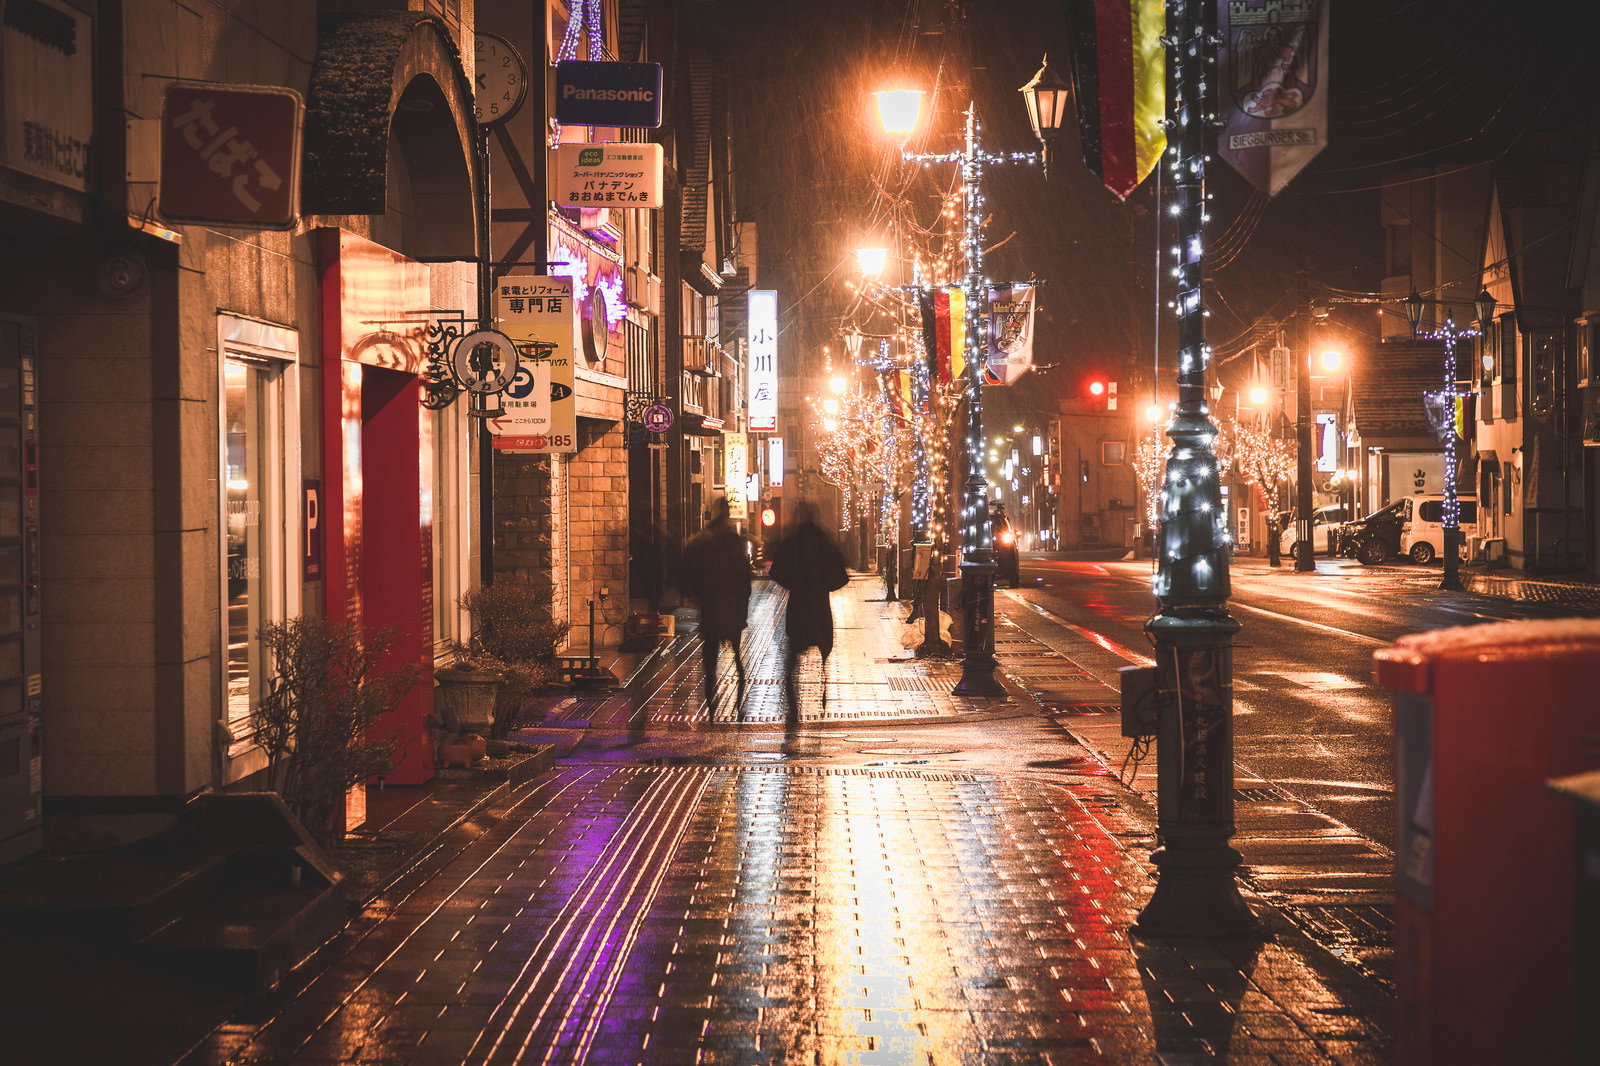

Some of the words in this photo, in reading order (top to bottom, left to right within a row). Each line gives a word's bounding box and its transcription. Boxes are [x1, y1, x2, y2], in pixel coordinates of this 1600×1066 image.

[491, 46, 496, 57] 1
[502, 56, 511, 67] 2
[507, 74, 516, 85] 3
[502, 90, 511, 101] 4
[563, 85, 654, 102] Panasonic
[490, 103, 499, 114] 5
[1232, 131, 1294, 148] SIEGBURGER
[172, 97, 283, 213] たばこ
[581, 156, 601, 164] ideas
[568, 191, 648, 202] おおぬまでんき
[501, 285, 570, 296] 家電とリフォーム
[509, 298, 562, 314] 専門店
[752, 327, 774, 402] 小川屋
[508, 371, 530, 394] P
[306, 489, 318, 557] P
